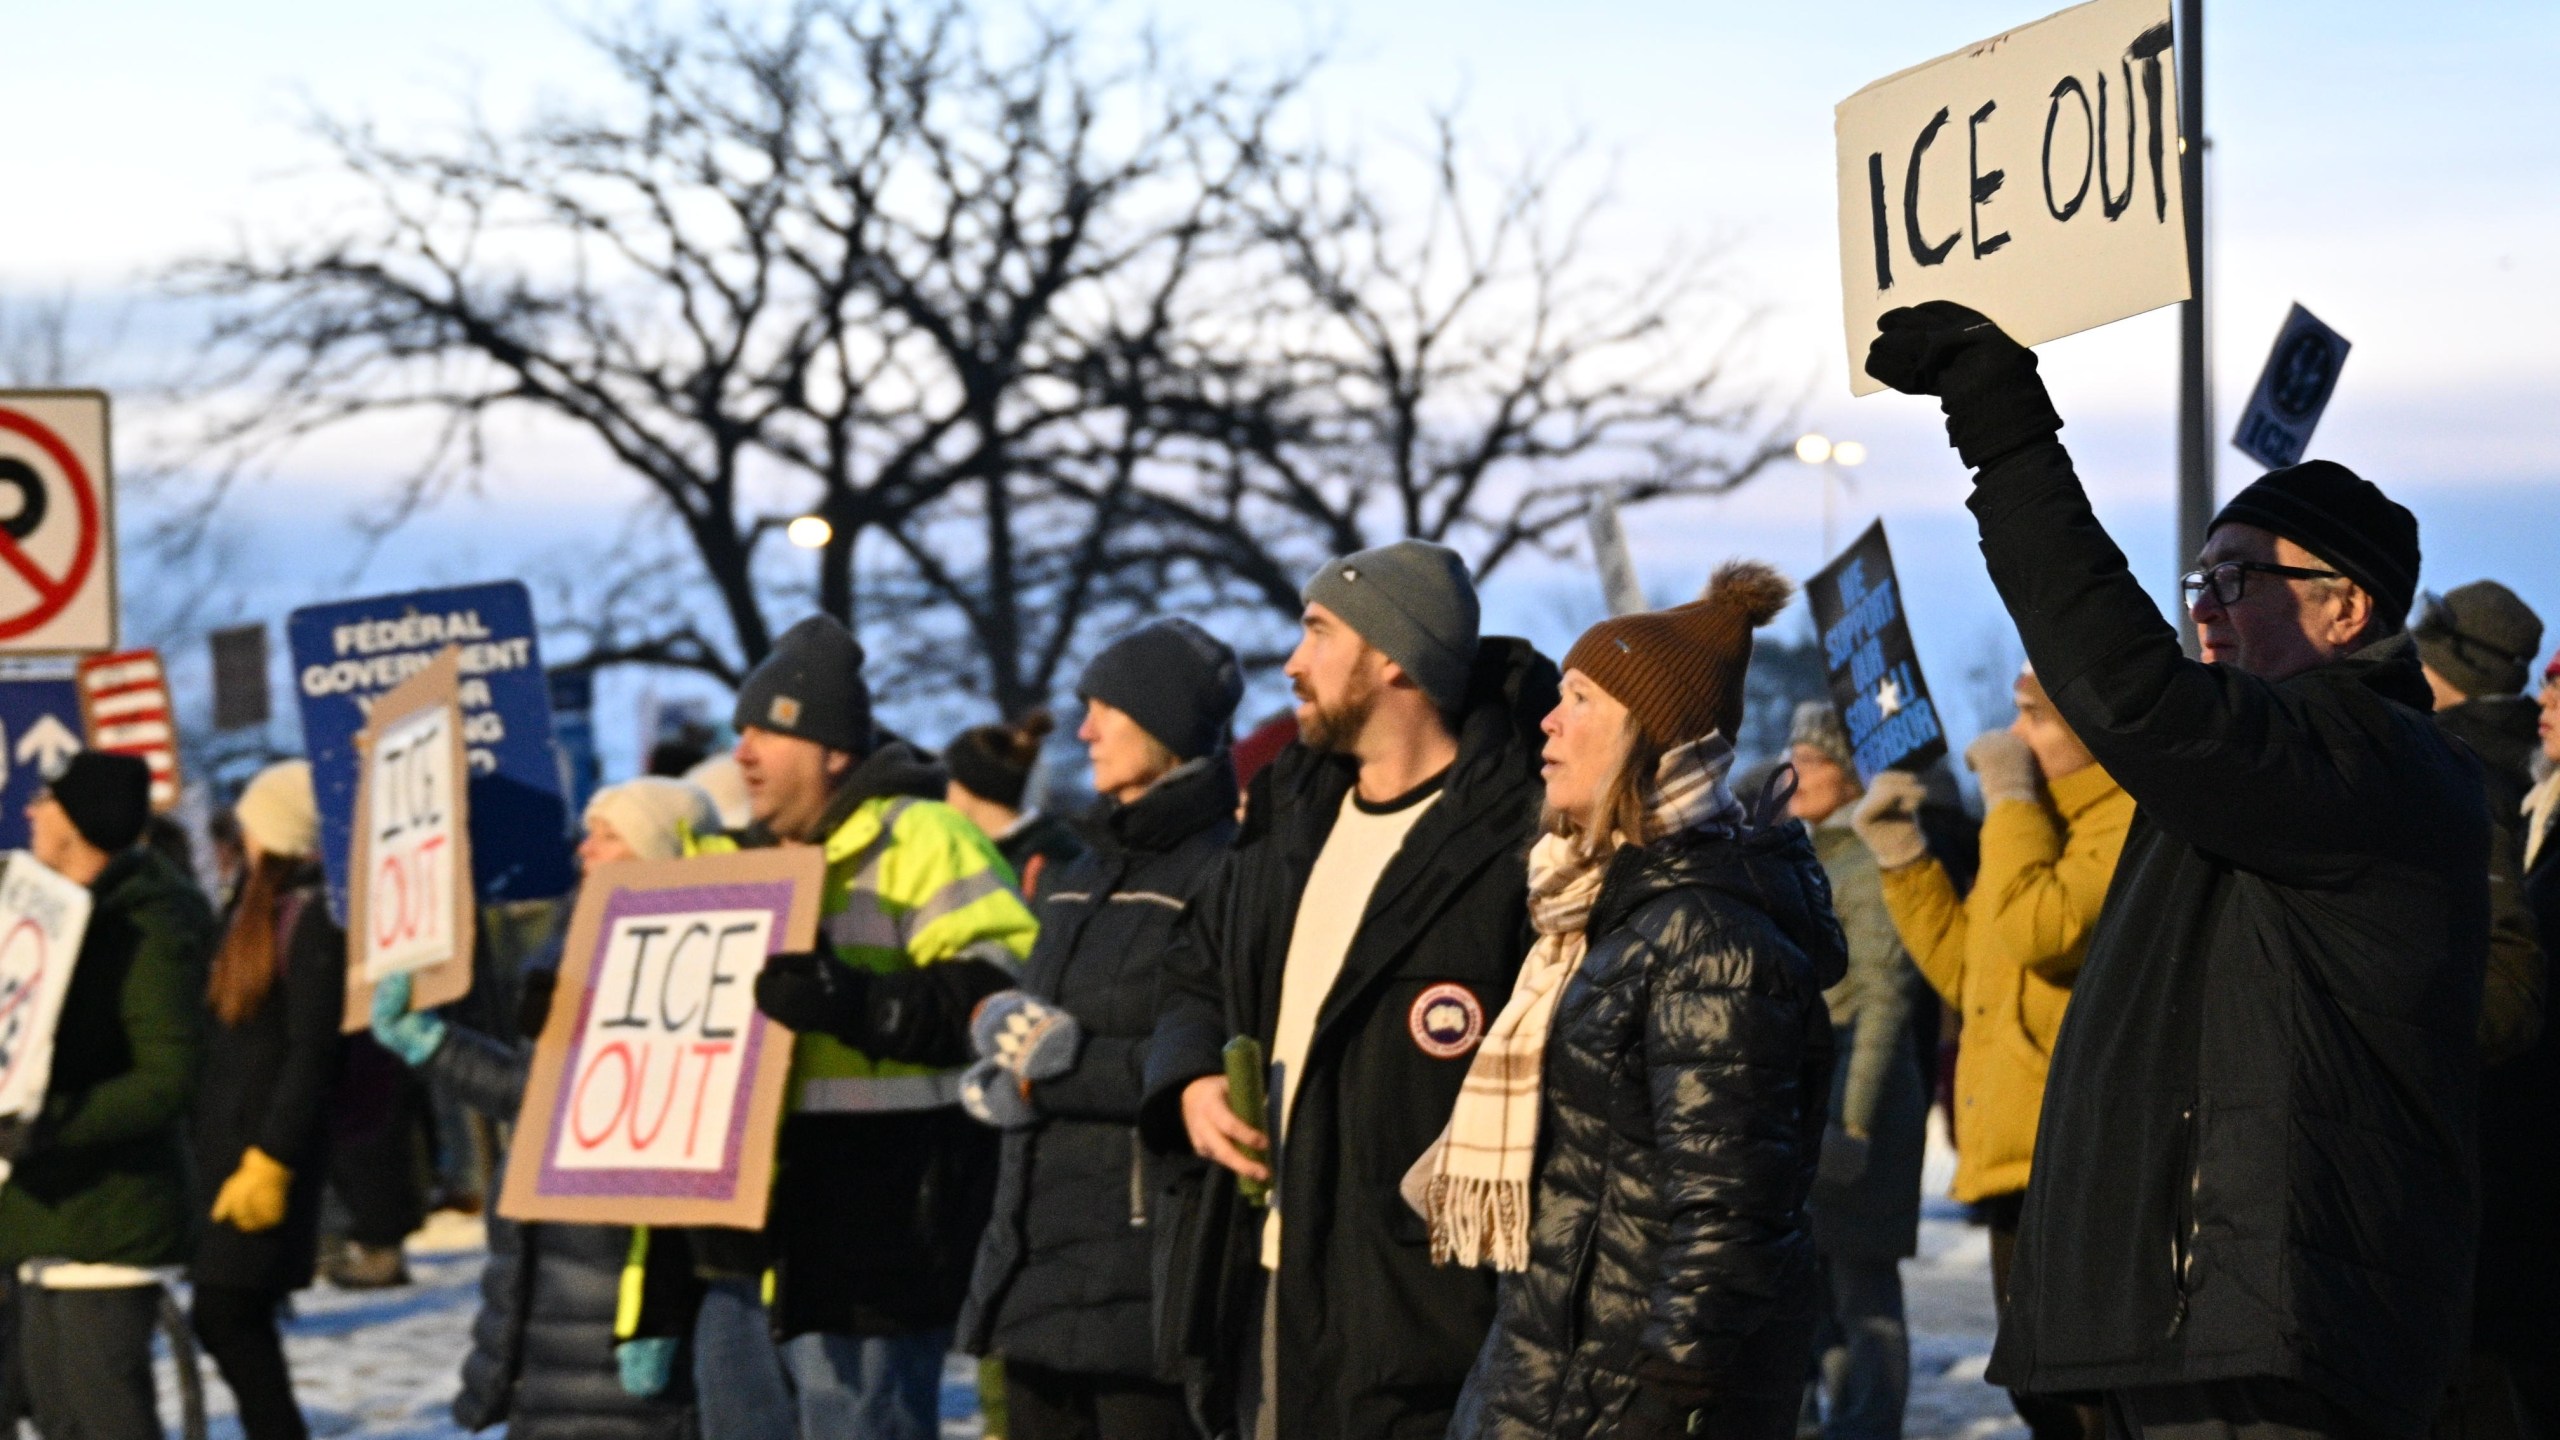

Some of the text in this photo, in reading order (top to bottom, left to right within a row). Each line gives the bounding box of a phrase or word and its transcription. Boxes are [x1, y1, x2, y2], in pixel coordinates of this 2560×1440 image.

[1869, 20, 2173, 292] ICE OUT
[302, 637, 531, 697] GOVERNENT
[1824, 577, 1897, 672] SUPPORT
[376, 835, 446, 949] OUT
[602, 923, 759, 1038] ICE
[572, 1041, 733, 1158] OUT
